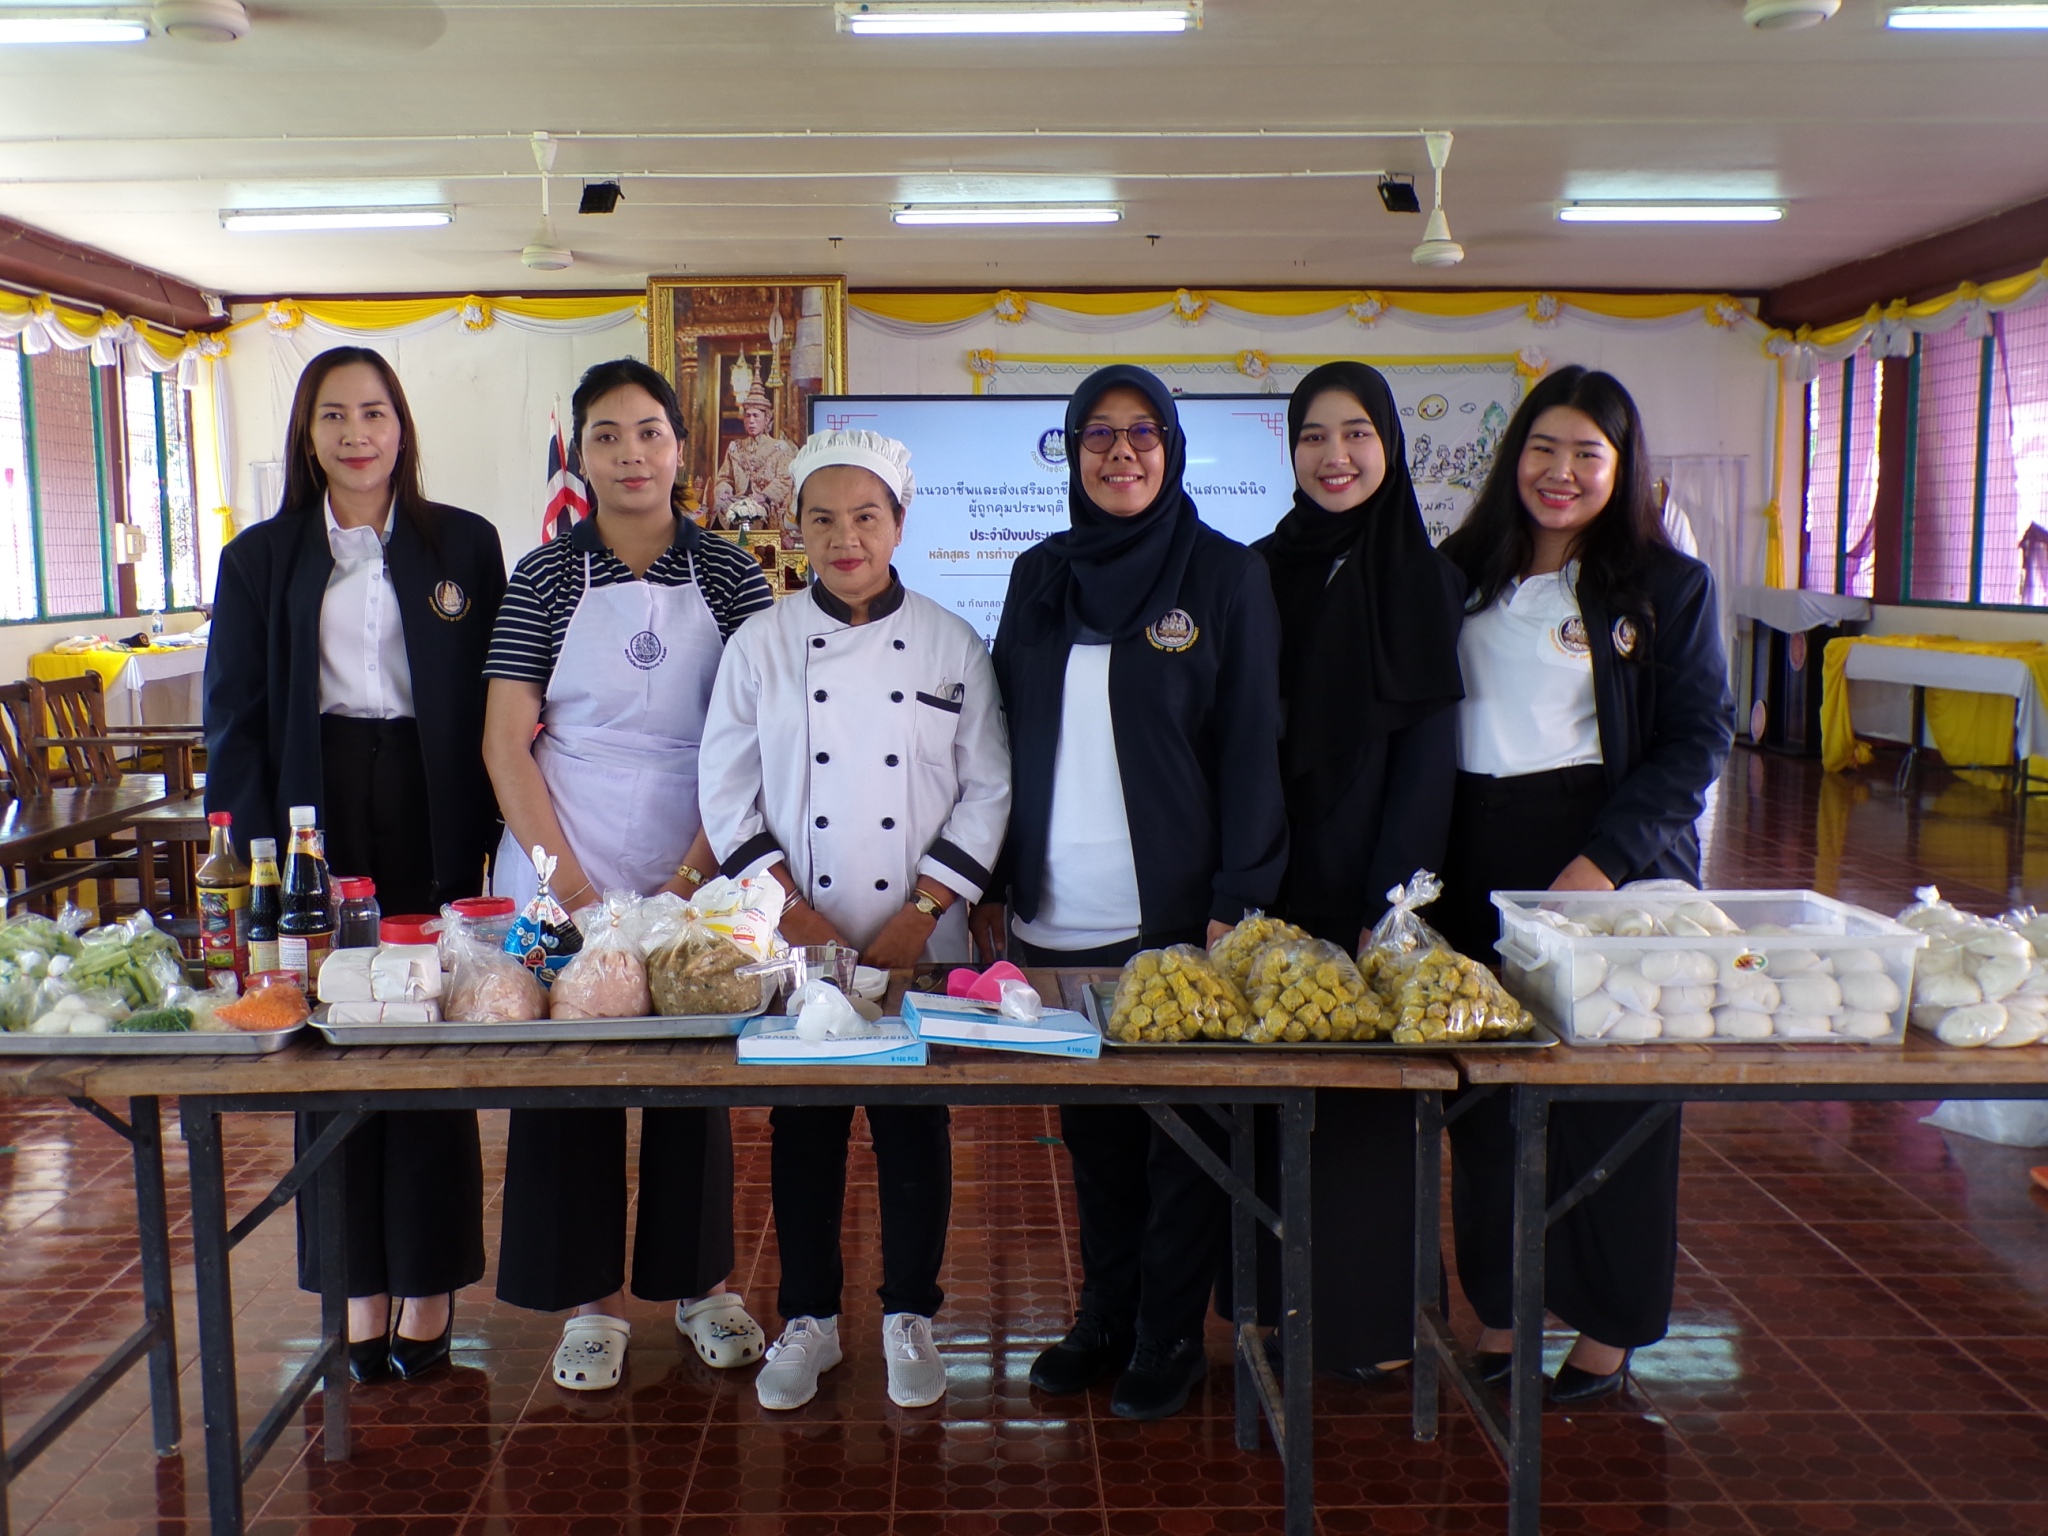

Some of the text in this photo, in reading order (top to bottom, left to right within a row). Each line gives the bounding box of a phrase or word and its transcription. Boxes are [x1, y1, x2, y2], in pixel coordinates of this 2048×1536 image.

[1185, 480, 1266, 495] ในสถานพินิจ
[968, 498, 1064, 518] ผู้ถูกคุมประพฤติ
[928, 547, 970, 563] หลักสูตร
